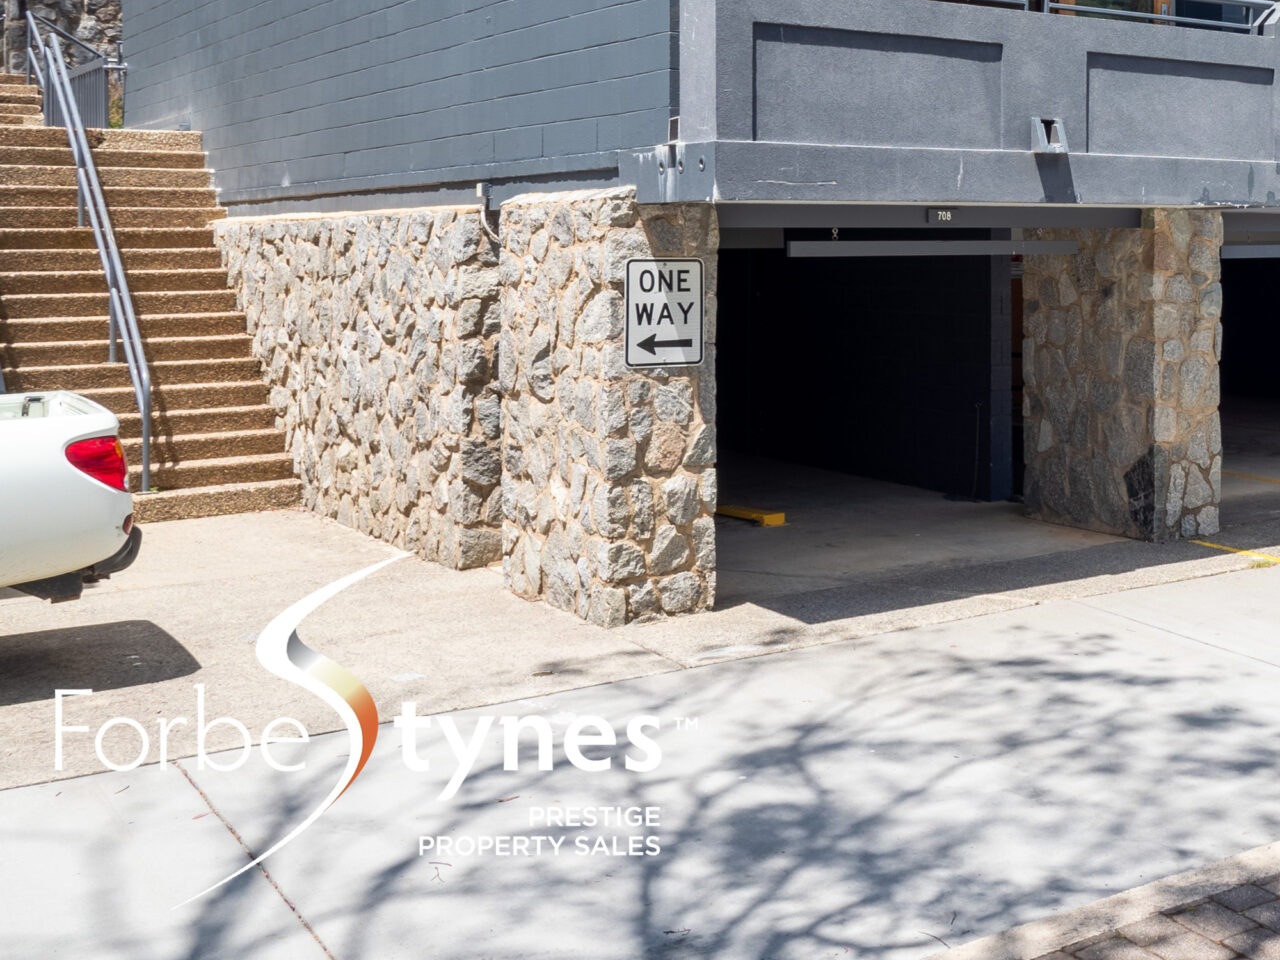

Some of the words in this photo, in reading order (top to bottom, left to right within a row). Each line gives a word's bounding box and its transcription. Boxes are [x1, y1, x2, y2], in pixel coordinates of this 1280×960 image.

[937, 211, 952, 221] 708
[639, 270, 691, 293] ONE
[635, 302, 695, 326] WAY
